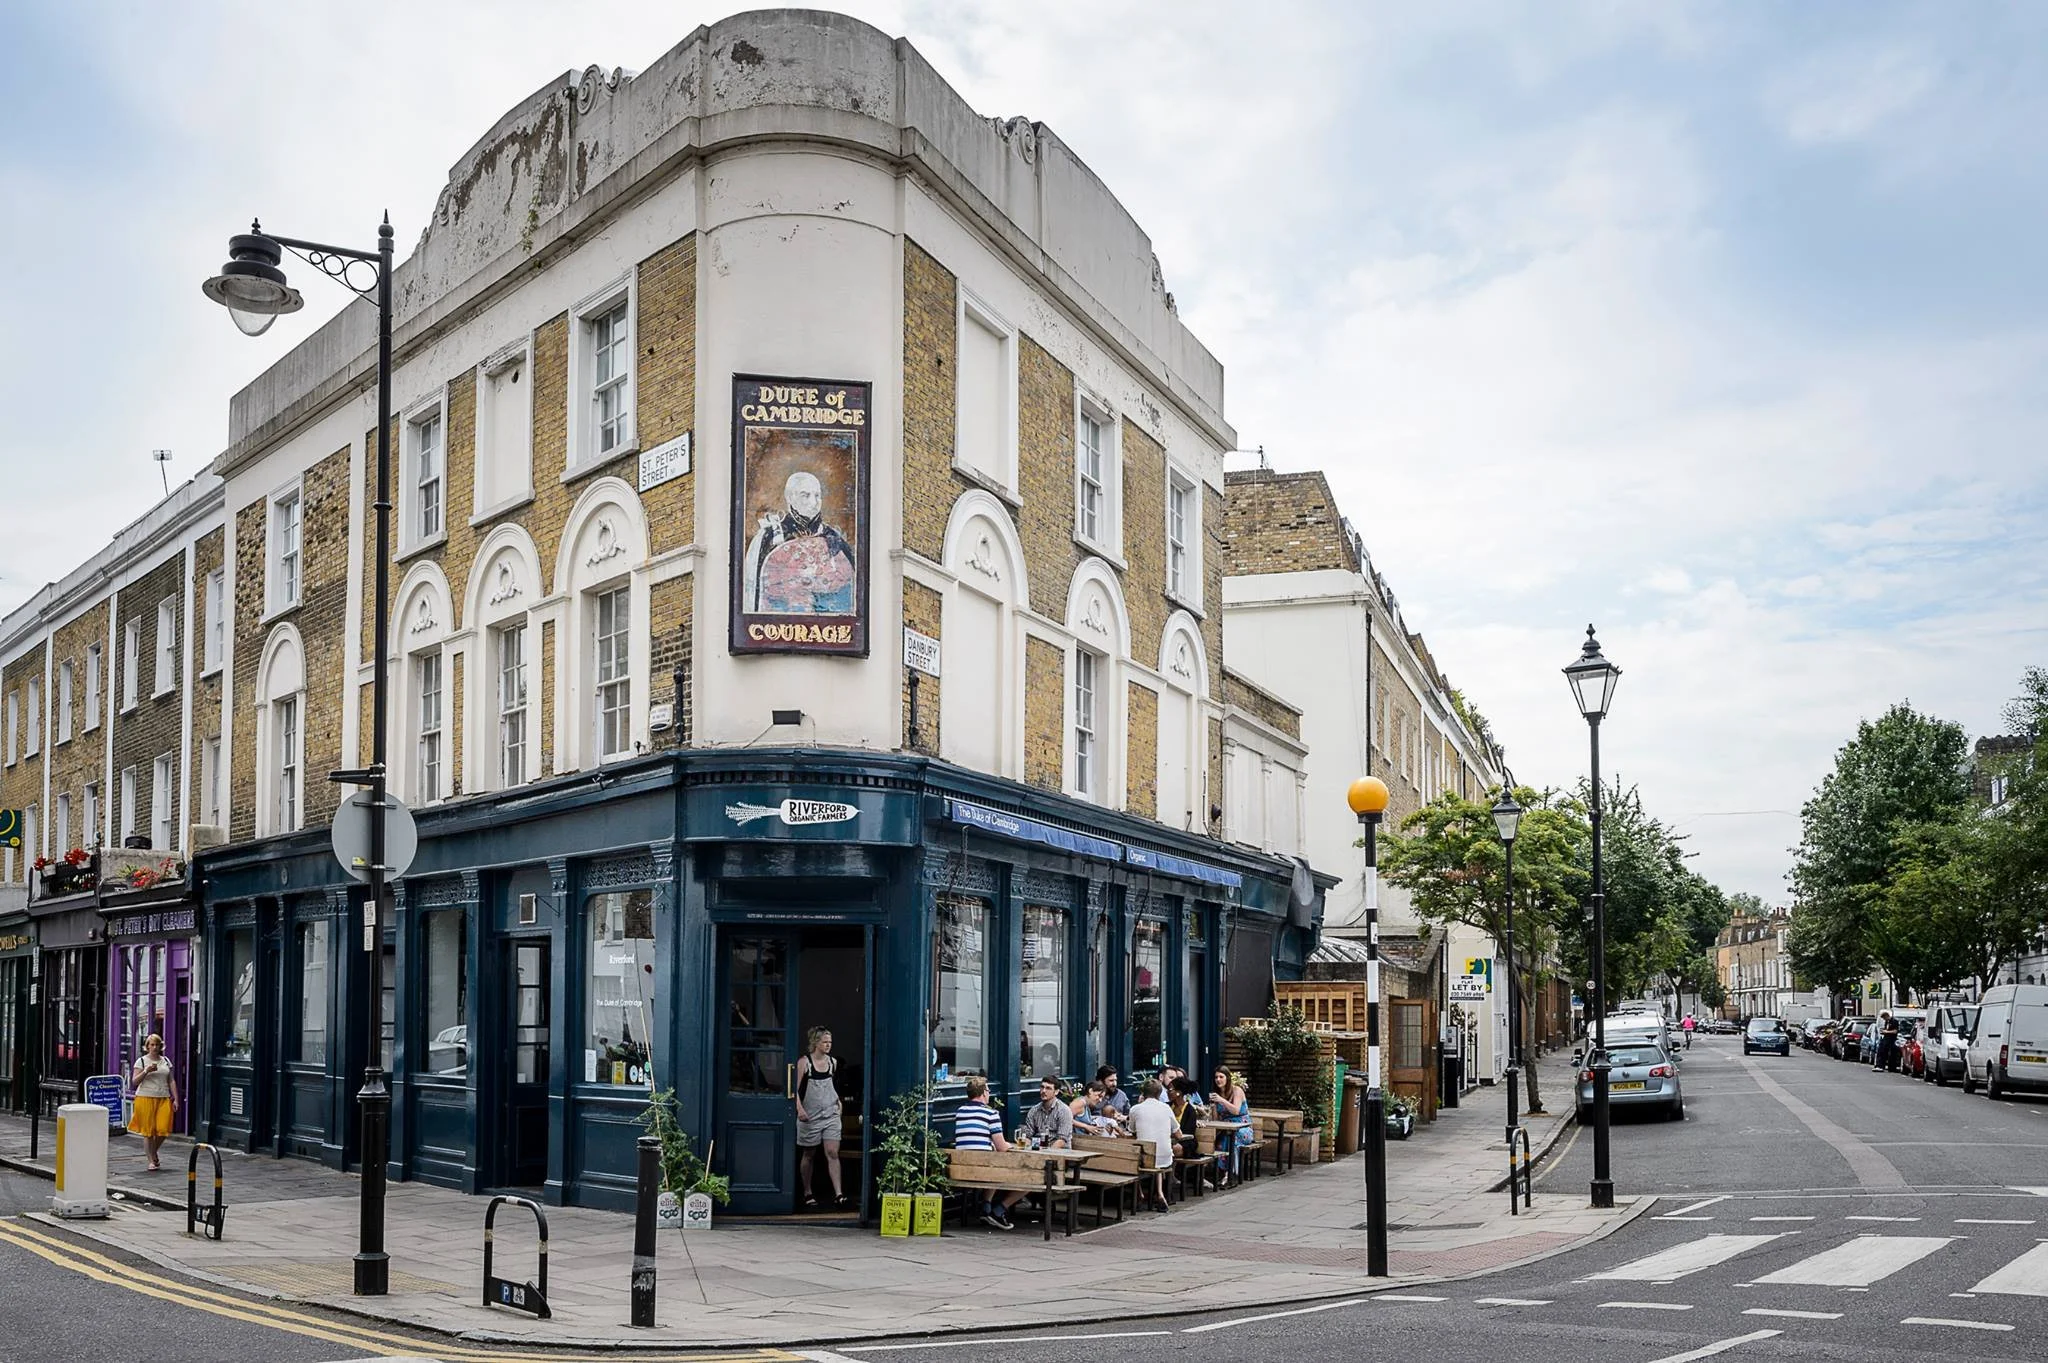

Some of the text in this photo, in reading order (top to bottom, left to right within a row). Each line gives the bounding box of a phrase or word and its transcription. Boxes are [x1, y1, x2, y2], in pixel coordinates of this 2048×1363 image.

[759, 386, 847, 409] DUKE of
[741, 404, 865, 426] CAMBRIDGE
[655, 443, 686, 468] PETER'S
[641, 465, 668, 487] STREET
[748, 623, 852, 644] COURAGE
[907, 636, 938, 659] DANBURY
[907, 651, 931, 670] STREET
[789, 801, 848, 816] RIVERFORD
[789, 812, 848, 822] ORGANIC FARMERS
[957, 804, 971, 819] The
[971, 807, 985, 823] Duke
[991, 812, 1021, 834] Cambridge
[1129, 849, 1147, 864] Organic
[162, 909, 195, 932] CLEANERS
